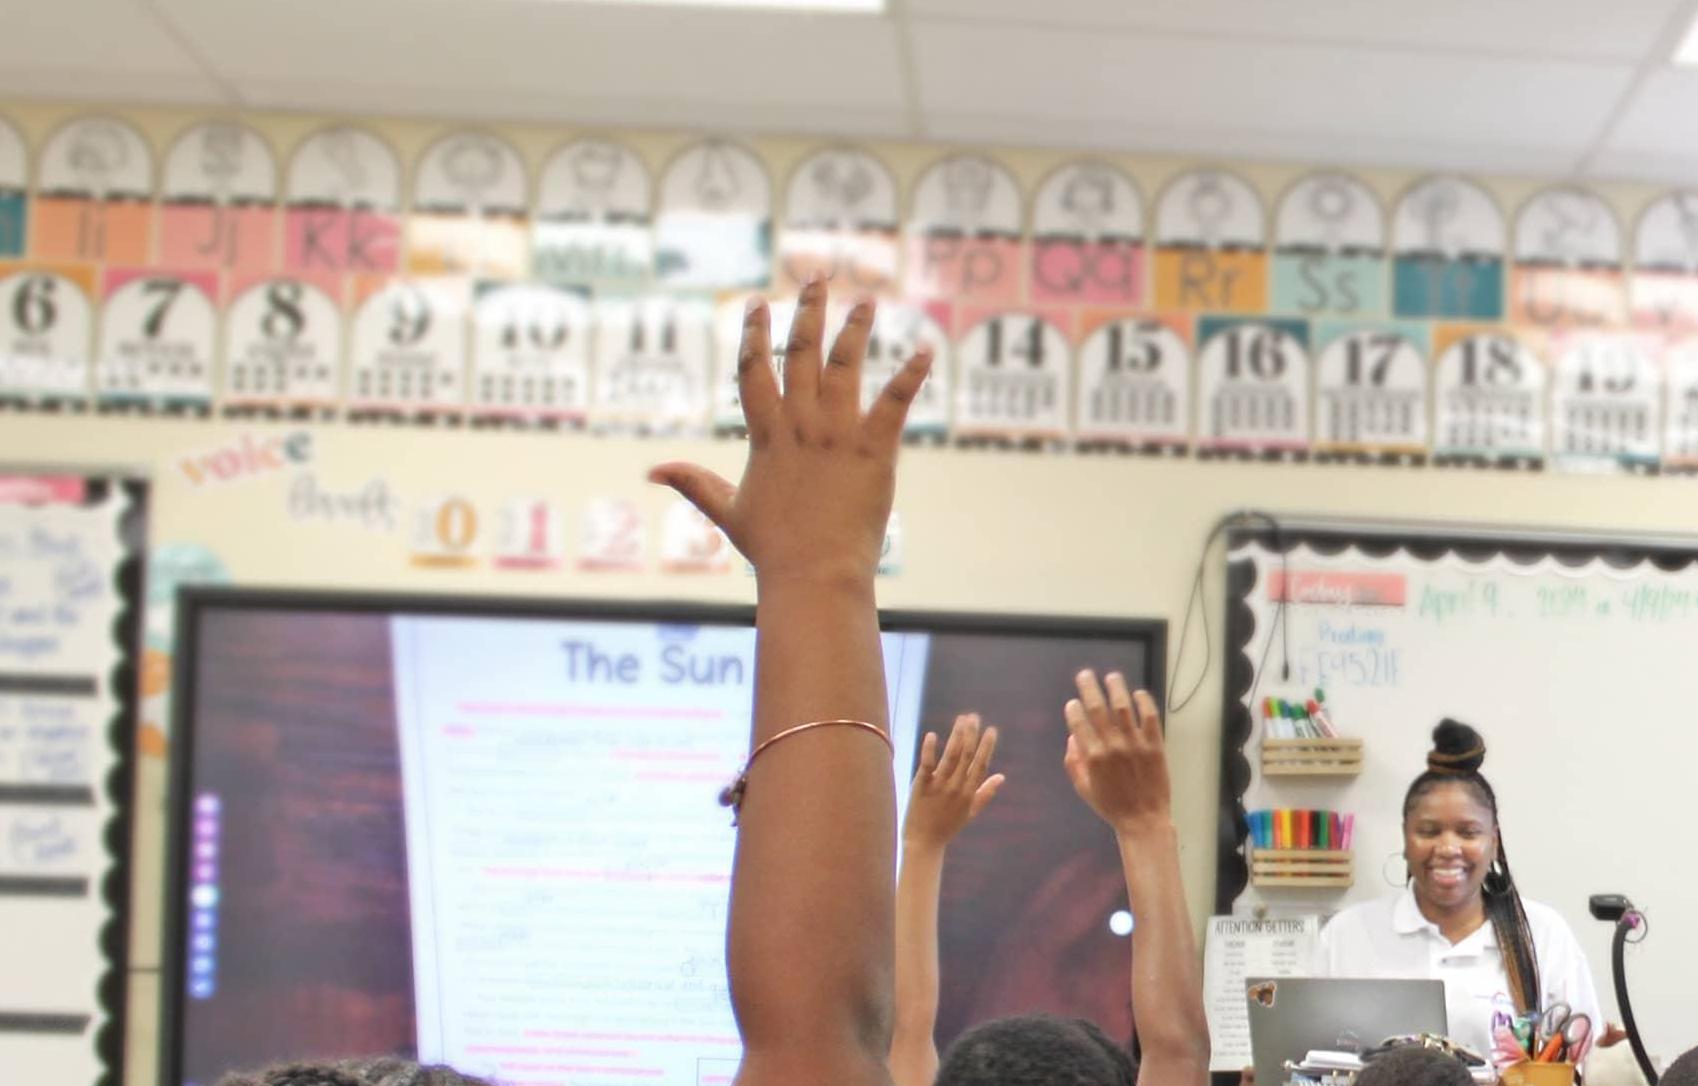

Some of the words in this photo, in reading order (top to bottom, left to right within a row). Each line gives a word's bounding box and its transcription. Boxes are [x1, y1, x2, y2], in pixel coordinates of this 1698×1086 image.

[304, 205, 376, 270] Kk
[1034, 245, 1134, 298] Qq
[1179, 251, 1243, 305] Rr
[1297, 254, 1360, 313] Ss
[12, 277, 56, 335] 6
[141, 279, 183, 338] 7
[261, 279, 306, 339] 8
[985, 317, 1045, 367] 14
[1106, 320, 1164, 373] 15
[1223, 328, 1287, 380] 16
[1344, 334, 1401, 387] 17
[1460, 337, 1522, 387] 18
[179, 432, 312, 487] voice
[560, 641, 640, 683] The
[660, 645, 744, 684] Sun
[1214, 919, 1262, 935] ATTENTION
[1265, 919, 1305, 936] GETTERS
